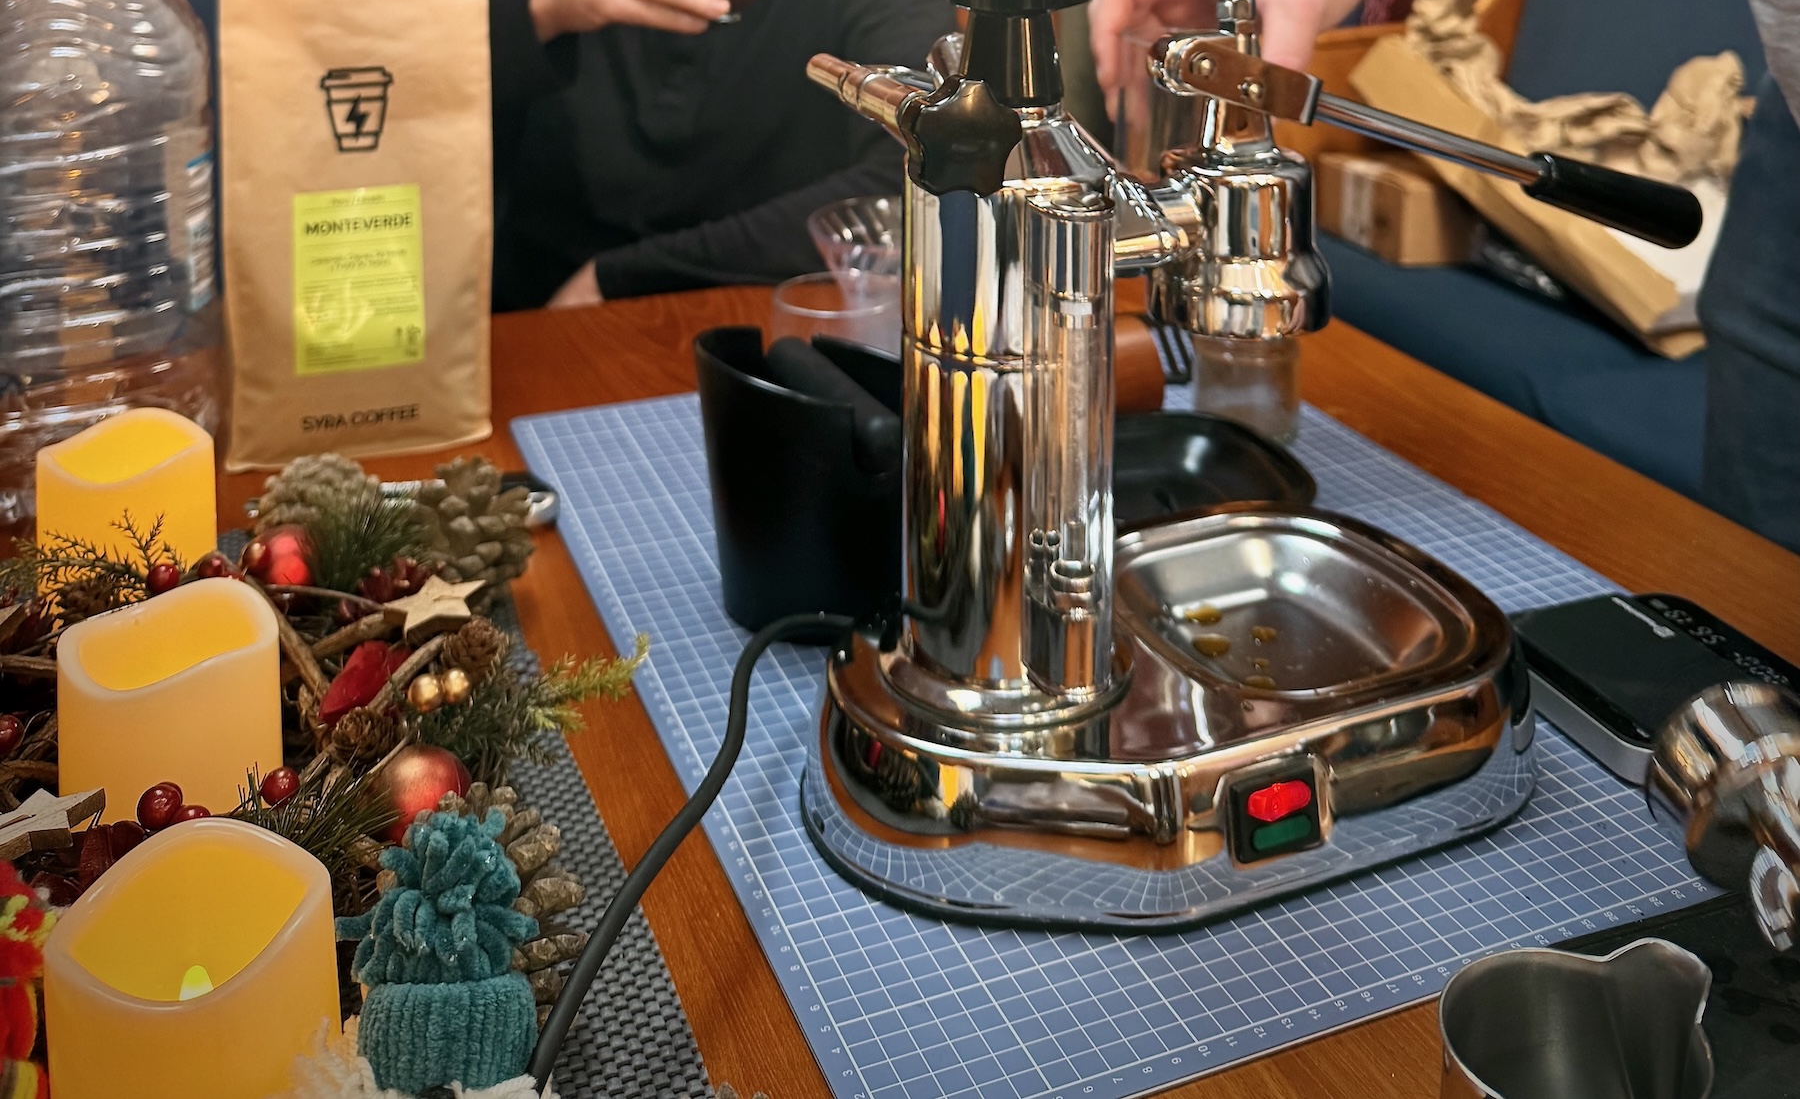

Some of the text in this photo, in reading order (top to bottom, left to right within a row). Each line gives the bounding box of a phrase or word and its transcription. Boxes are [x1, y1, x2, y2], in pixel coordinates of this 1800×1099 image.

[305, 212, 413, 236] MONTEVERDE
[350, 403, 420, 428] COFFEE
[1692, 882, 1707, 892] 30
[1670, 889, 1686, 899] 29
[1648, 896, 1664, 907] 28
[1626, 904, 1642, 914] 27
[1603, 911, 1619, 922] 26
[770, 924, 781, 935] 10
[1581, 918, 1596, 930] 25
[1558, 926, 1573, 938] 24
[1534, 934, 1550, 945] 23
[780, 945, 790, 953] 9
[1437, 966, 1451, 977] 19
[1411, 974, 1426, 986] 18
[1386, 983, 1400, 994] 17
[1360, 991, 1375, 1003] 16
[810, 1004, 820, 1012] 6
[1334, 999, 1348, 1012] 15
[1308, 1008, 1321, 1021] 14
[820, 1025, 831, 1033] 5
[1281, 1017, 1295, 1030] 13
[1253, 1026, 1267, 1038] 12
[1225, 1036, 1238, 1047] 11
[1197, 1045, 1211, 1057] 10
[1171, 1057, 1182, 1065] 9
[842, 1069, 853, 1077] 3
[1142, 1066, 1153, 1074] 8
[1083, 1086, 1094, 1094] 6
